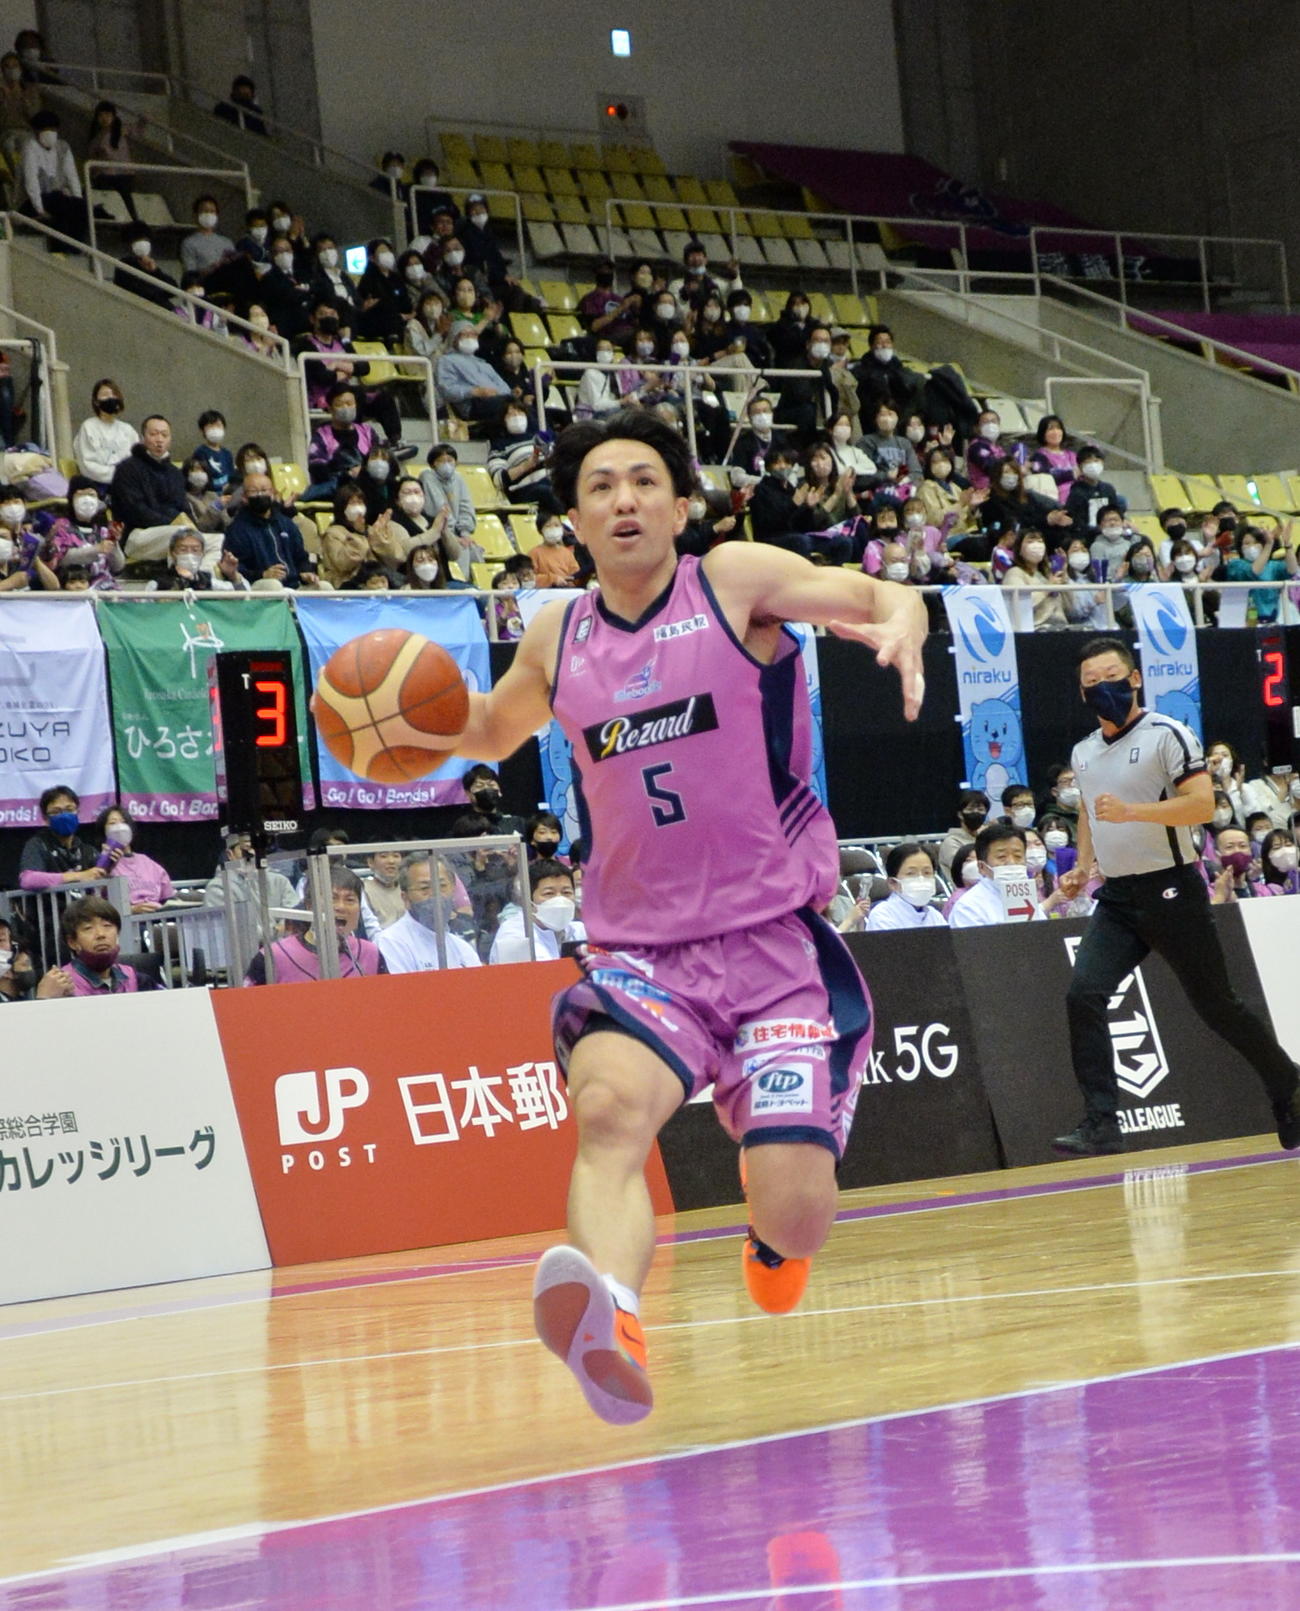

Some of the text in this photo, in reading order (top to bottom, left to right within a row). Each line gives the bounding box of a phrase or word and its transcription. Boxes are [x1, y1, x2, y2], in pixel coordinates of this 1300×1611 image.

[963, 665, 1012, 684] niraku
[1148, 660, 1193, 677] niraku
[1264, 652, 1283, 706] 2
[0, 721, 71, 738] UYA
[255, 681, 286, 747] 3
[600, 696, 696, 759] Rezard
[128, 800, 156, 817] Go!
[160, 800, 185, 816] Go!
[327, 787, 435, 803] Go! Go! Bonds!
[641, 761, 688, 829] 5
[264, 820, 298, 831] SEIKO
[894, 1023, 959, 1081] 5G
[397, 1061, 570, 1146] 日本郵
[764, 1072, 798, 1092] ftp
[274, 1067, 370, 1146] JP
[0, 1125, 216, 1192] カレッジリーグ
[281, 1143, 377, 1175] POST
